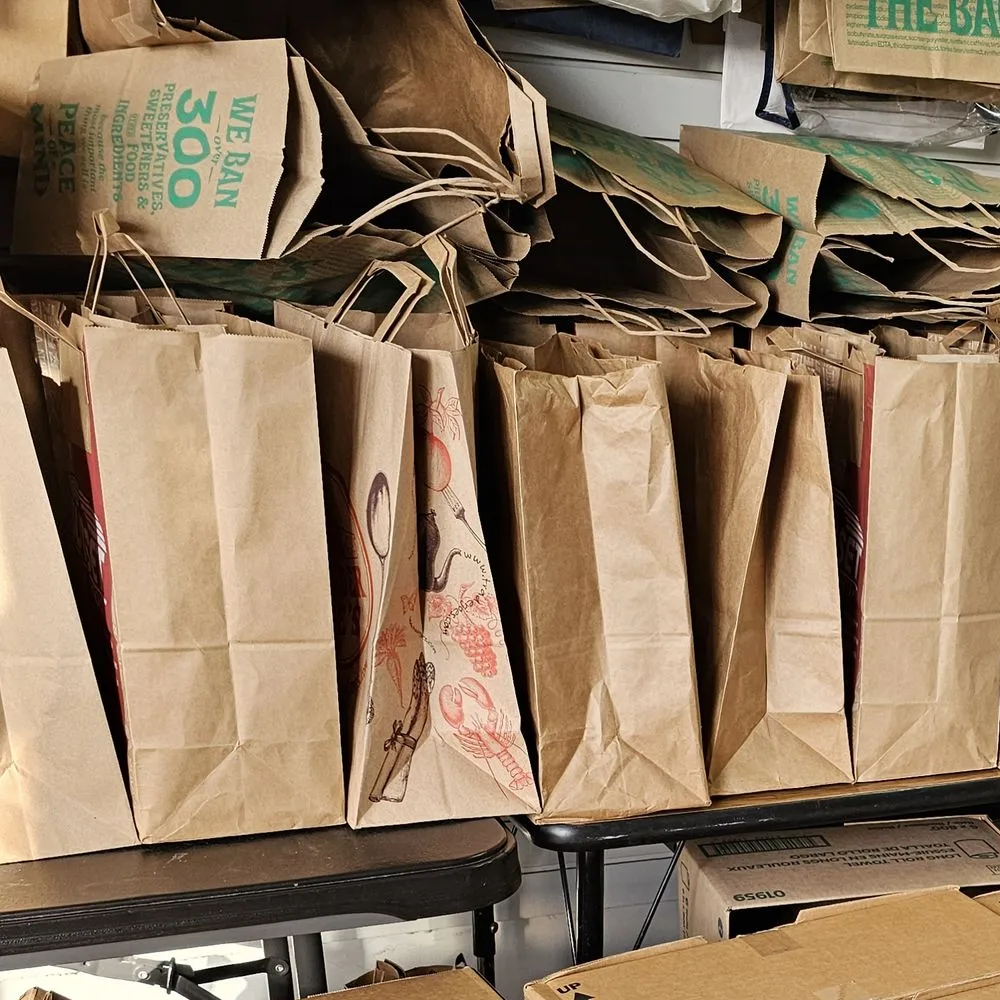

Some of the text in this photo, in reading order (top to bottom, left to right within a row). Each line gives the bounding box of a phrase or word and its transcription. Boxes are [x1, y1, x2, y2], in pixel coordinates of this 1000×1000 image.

[866, 0, 939, 33] THE
[57, 102, 80, 194] PEACE
[87, 131, 99, 195] important
[96, 113, 109, 182] because the
[111, 100, 130, 202] INGREDIENTS
[125, 144, 139, 183] FOOD
[137, 88, 161, 209] SWEETENERS &
[150, 83, 176, 215] PRESERVATIVES,
[168, 87, 217, 209] 300
[211, 136, 221, 165] over
[213, 94, 257, 208] WE BAN
[786, 236, 807, 286] BAN
[790, 851, 835, 859] LARGO
[802, 856, 847, 864] LONGS
[869, 848, 956, 859] ESSUIE-MAINS
[901, 842, 951, 850] TOALLA
[926, 853, 962, 861] LONG
[727, 860, 800, 872] ROULEAUX
[843, 859, 890, 867] TOWEL
[733, 889, 786, 902] 01959
[556, 982, 581, 994] UP
